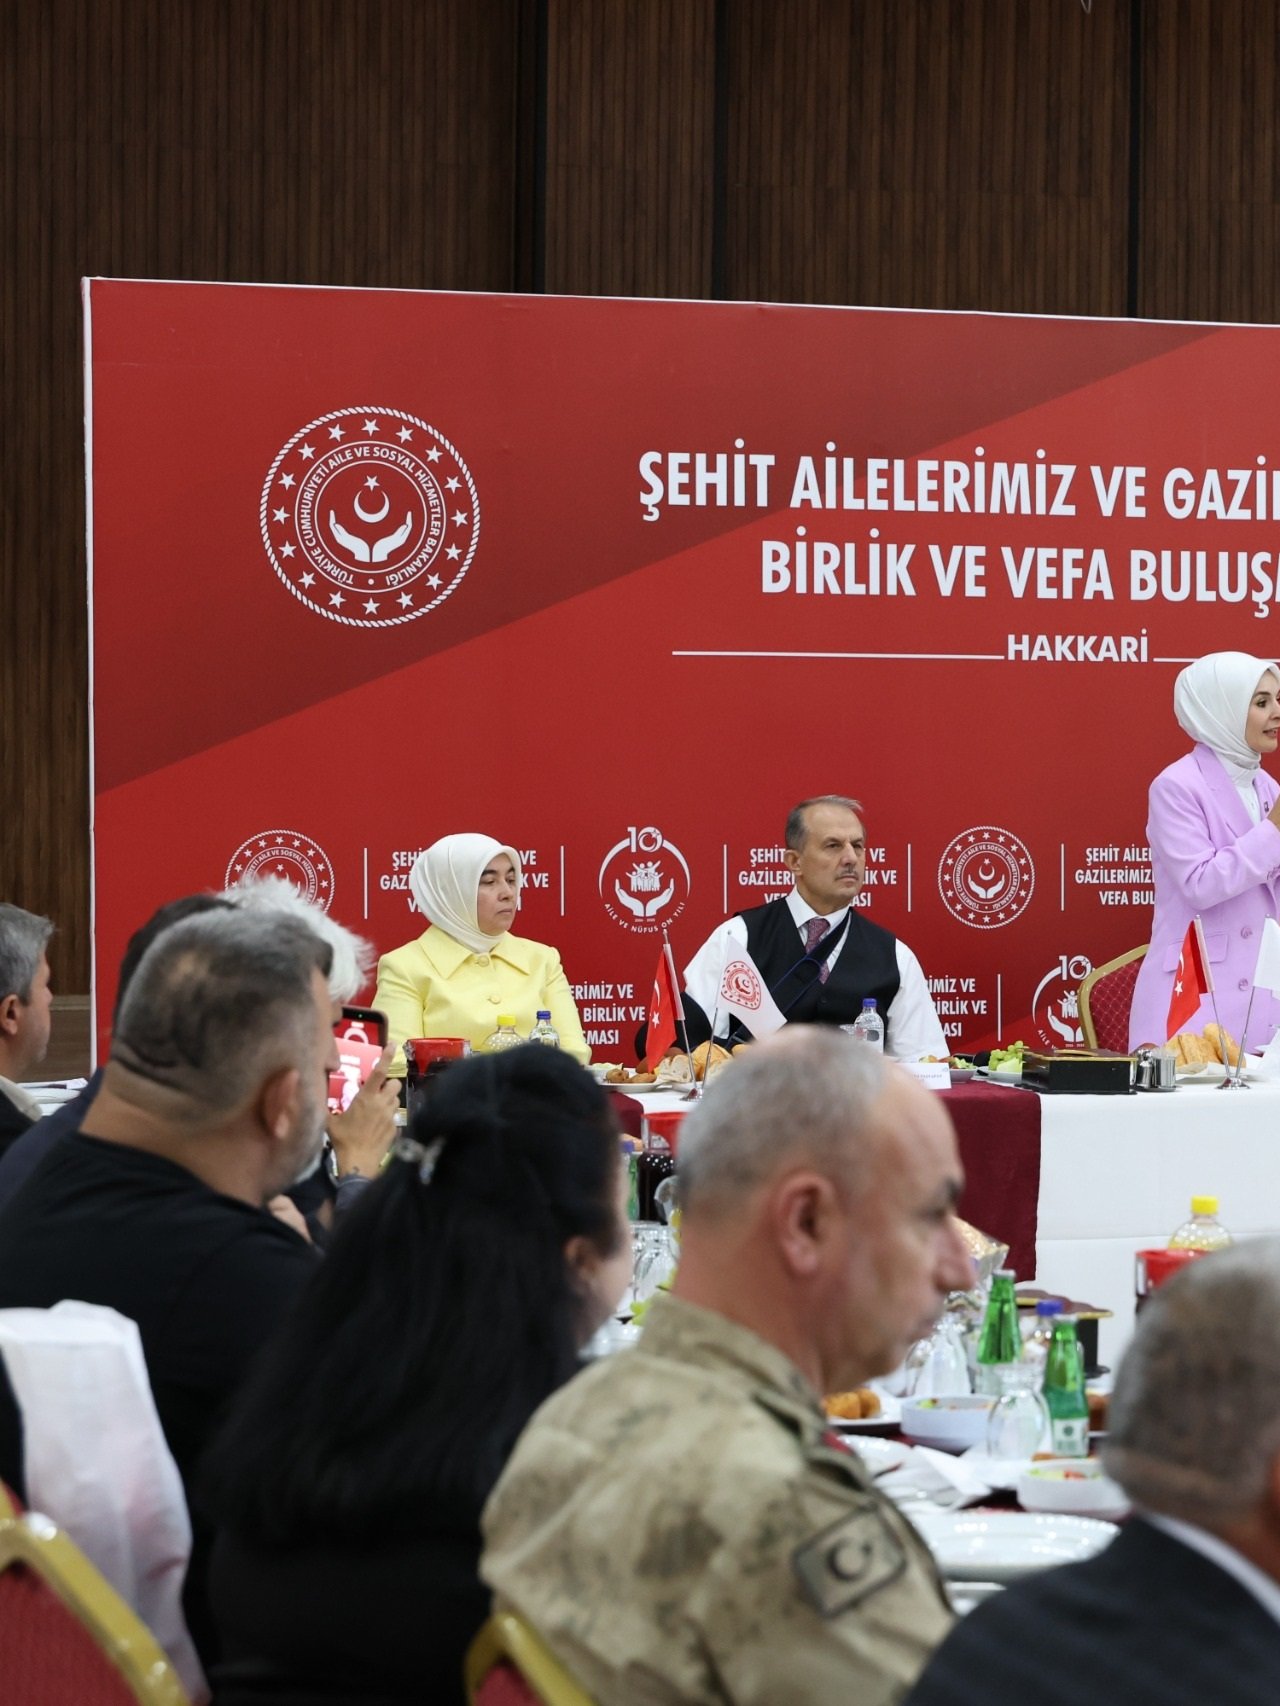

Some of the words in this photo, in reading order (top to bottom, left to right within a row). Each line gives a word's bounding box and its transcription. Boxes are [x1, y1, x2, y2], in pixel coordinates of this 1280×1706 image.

[328, 450, 354, 470] AİLE
[354, 446, 370, 457] VE
[372, 447, 416, 473] SOSYAL
[639, 438, 775, 521] ŞEHİT
[790, 442, 1076, 515] AİLELERİMİZ
[1090, 466, 1146, 517] VE
[300, 463, 330, 547] CUMHURİYETİ
[415, 470, 442, 537] HİZMETLER
[311, 546, 354, 585] TÜRKİYE
[385, 538, 437, 586] BAKANLIĞI
[762, 526, 916, 596] BİRLİK
[928, 545, 986, 597] VE
[1001, 547, 1114, 600] VEFA
[1008, 629, 1147, 662] HAKKARİ
[869, 848, 886, 862] VE
[1086, 844, 1120, 866] ŞEHİT
[532, 873, 548, 888] VE
[881, 870, 896, 884] VE
[1099, 891, 1128, 905] VEFA
[617, 984, 634, 998] VE
[960, 978, 976, 992] VE
[584, 1003, 626, 1022] BİRLİK
[629, 1006, 646, 1021] VE
[971, 1000, 987, 1014] VE
